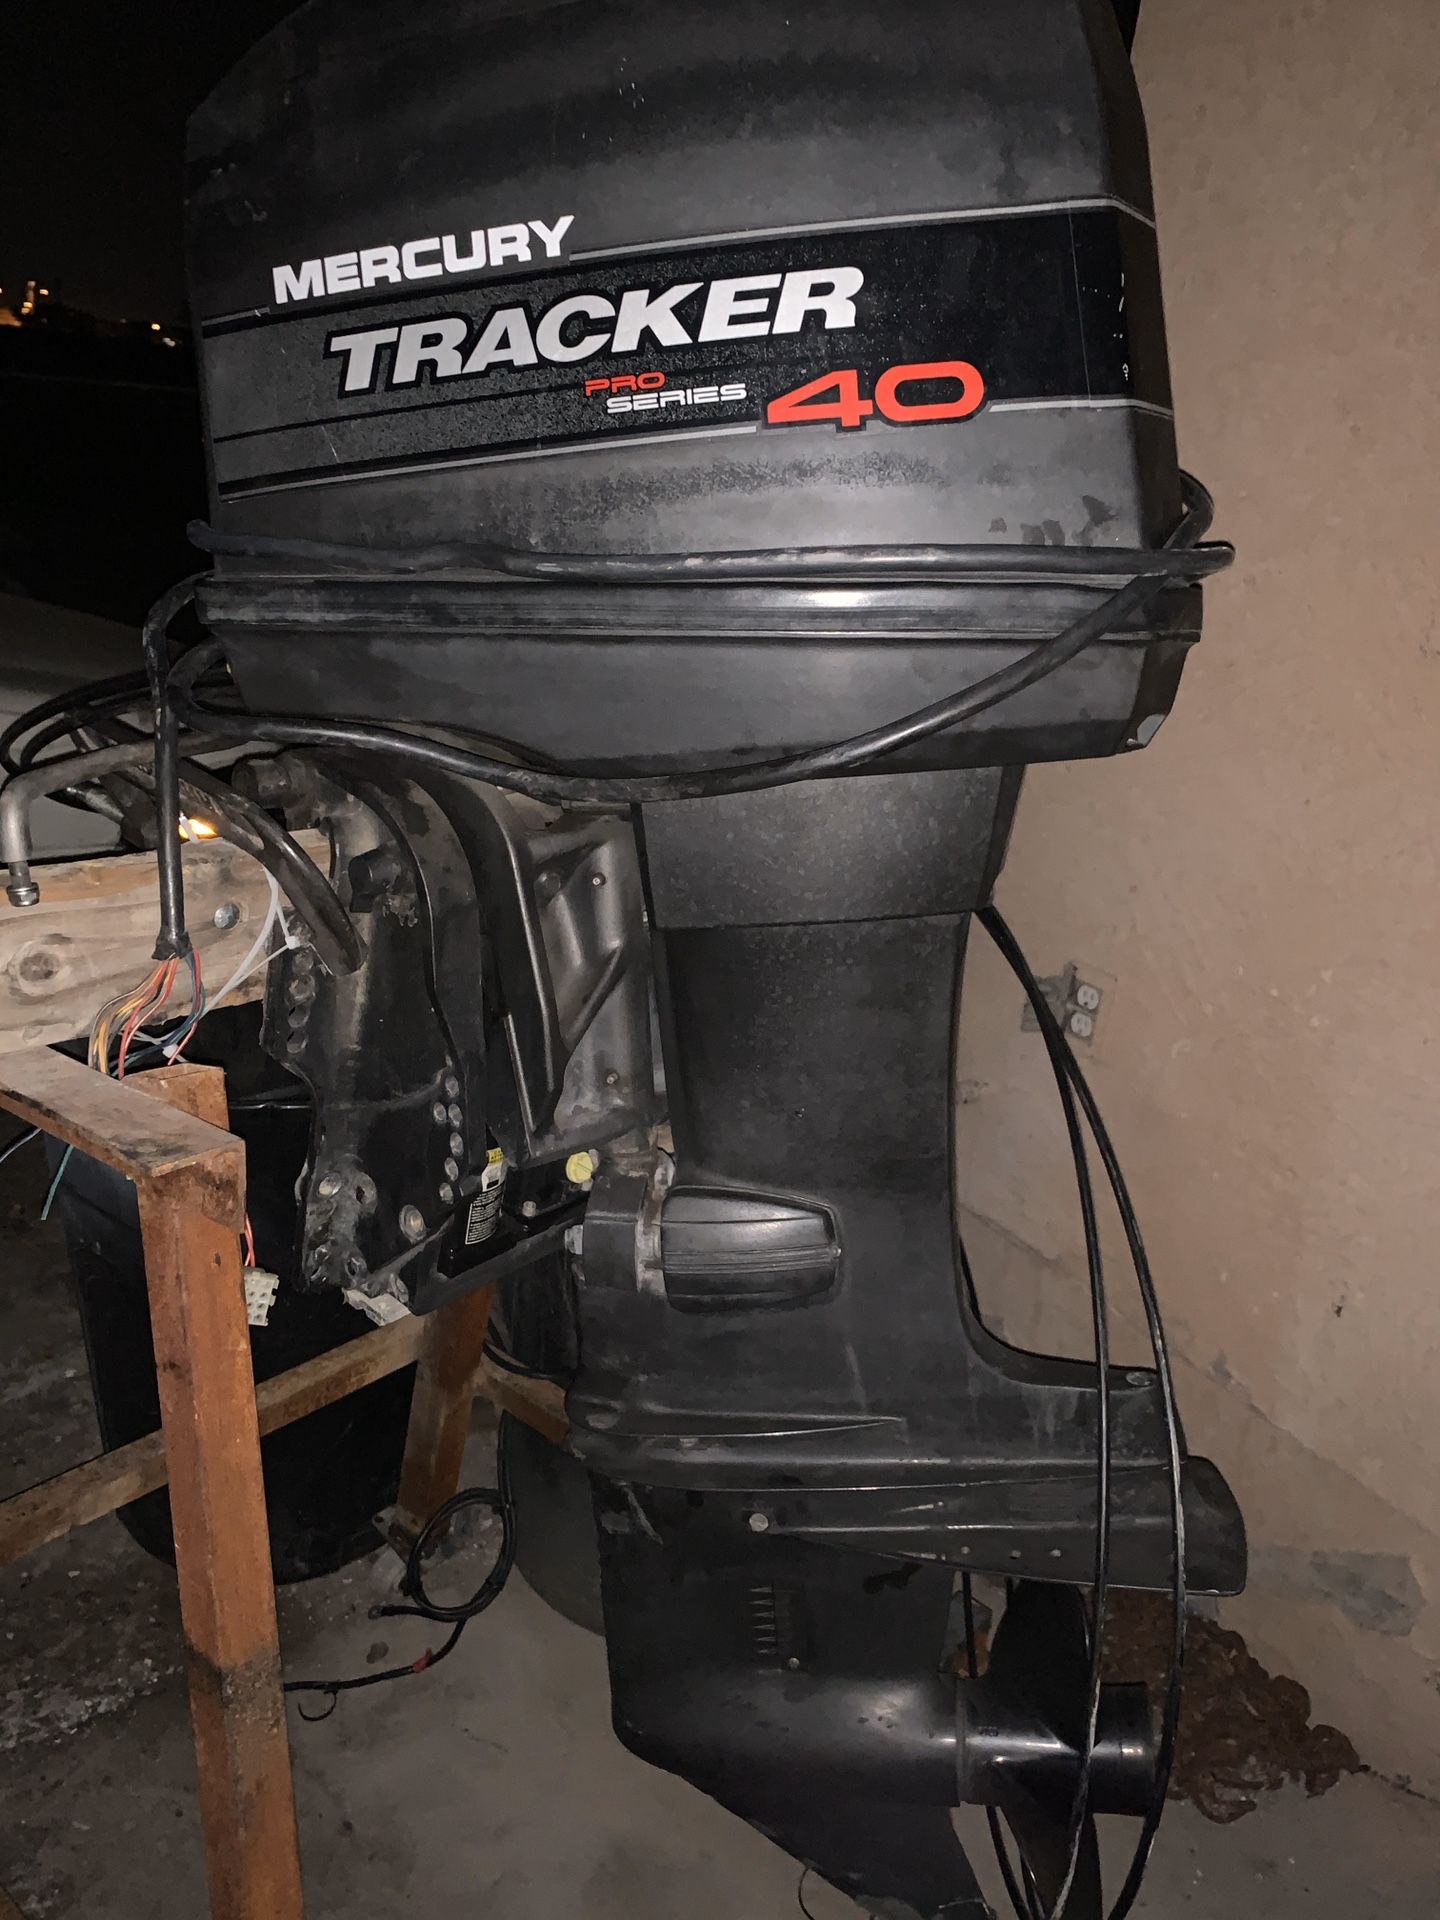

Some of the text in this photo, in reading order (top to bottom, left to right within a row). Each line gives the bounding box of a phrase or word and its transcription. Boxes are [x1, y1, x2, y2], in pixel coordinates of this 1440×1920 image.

[273, 215, 574, 304] MERCURY
[329, 267, 864, 391] TRACKER
[585, 371, 666, 396] PRO
[606, 383, 747, 414] SERIES
[767, 361, 985, 428] 40
